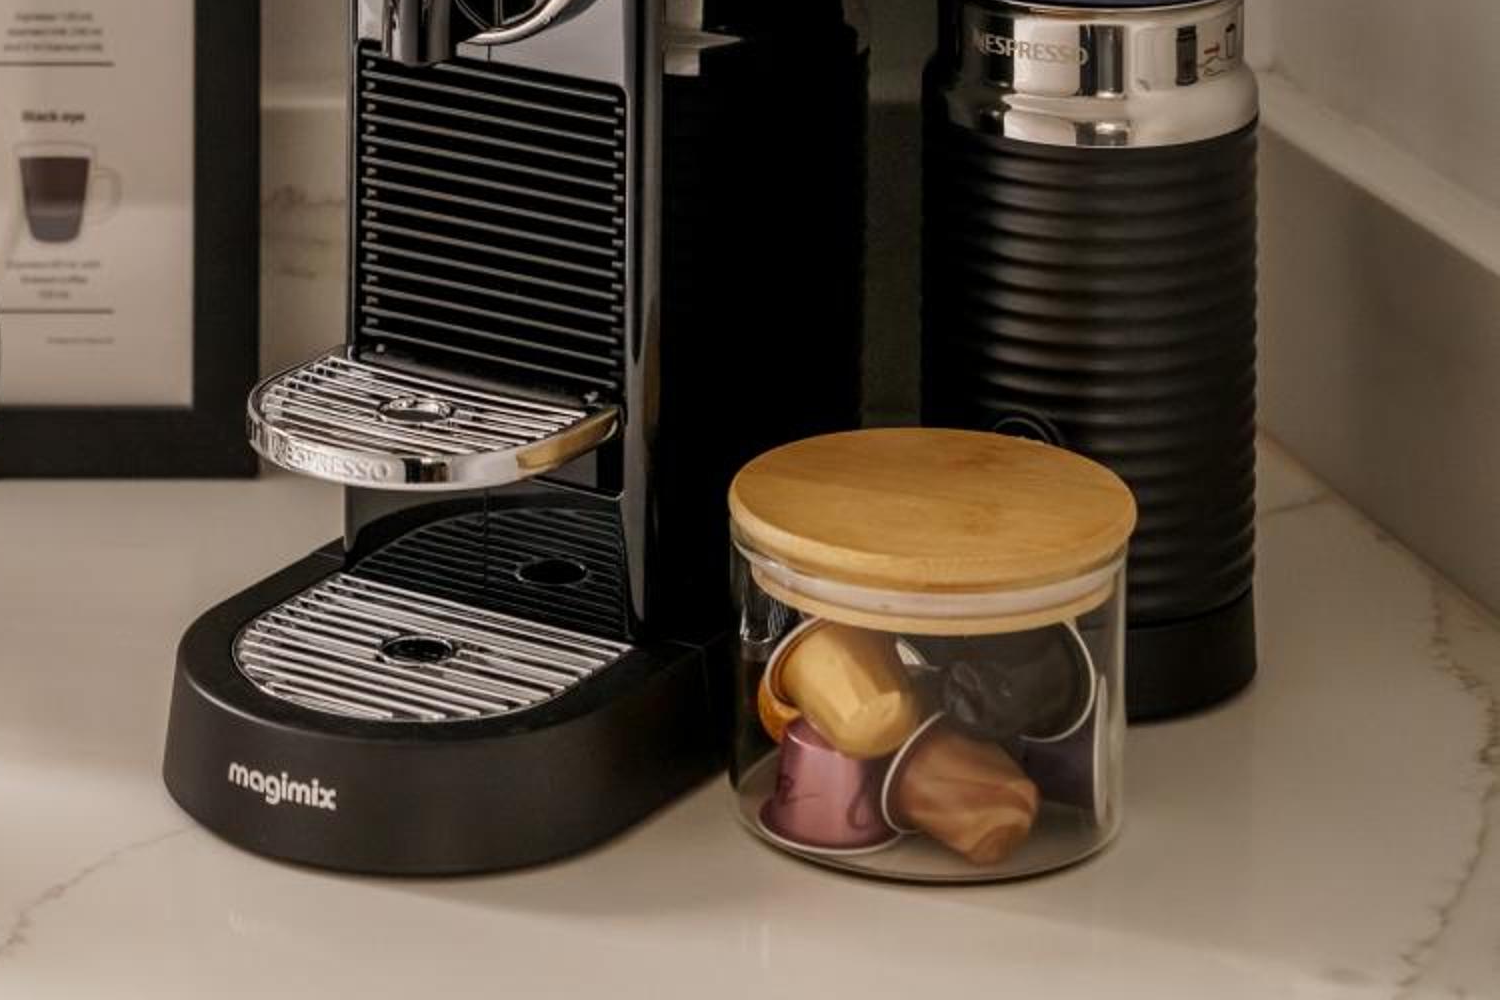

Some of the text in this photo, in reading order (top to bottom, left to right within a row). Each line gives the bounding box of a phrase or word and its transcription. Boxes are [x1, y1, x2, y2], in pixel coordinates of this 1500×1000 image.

[21, 108, 86, 126] Black eye
[227, 761, 338, 812] magimix
